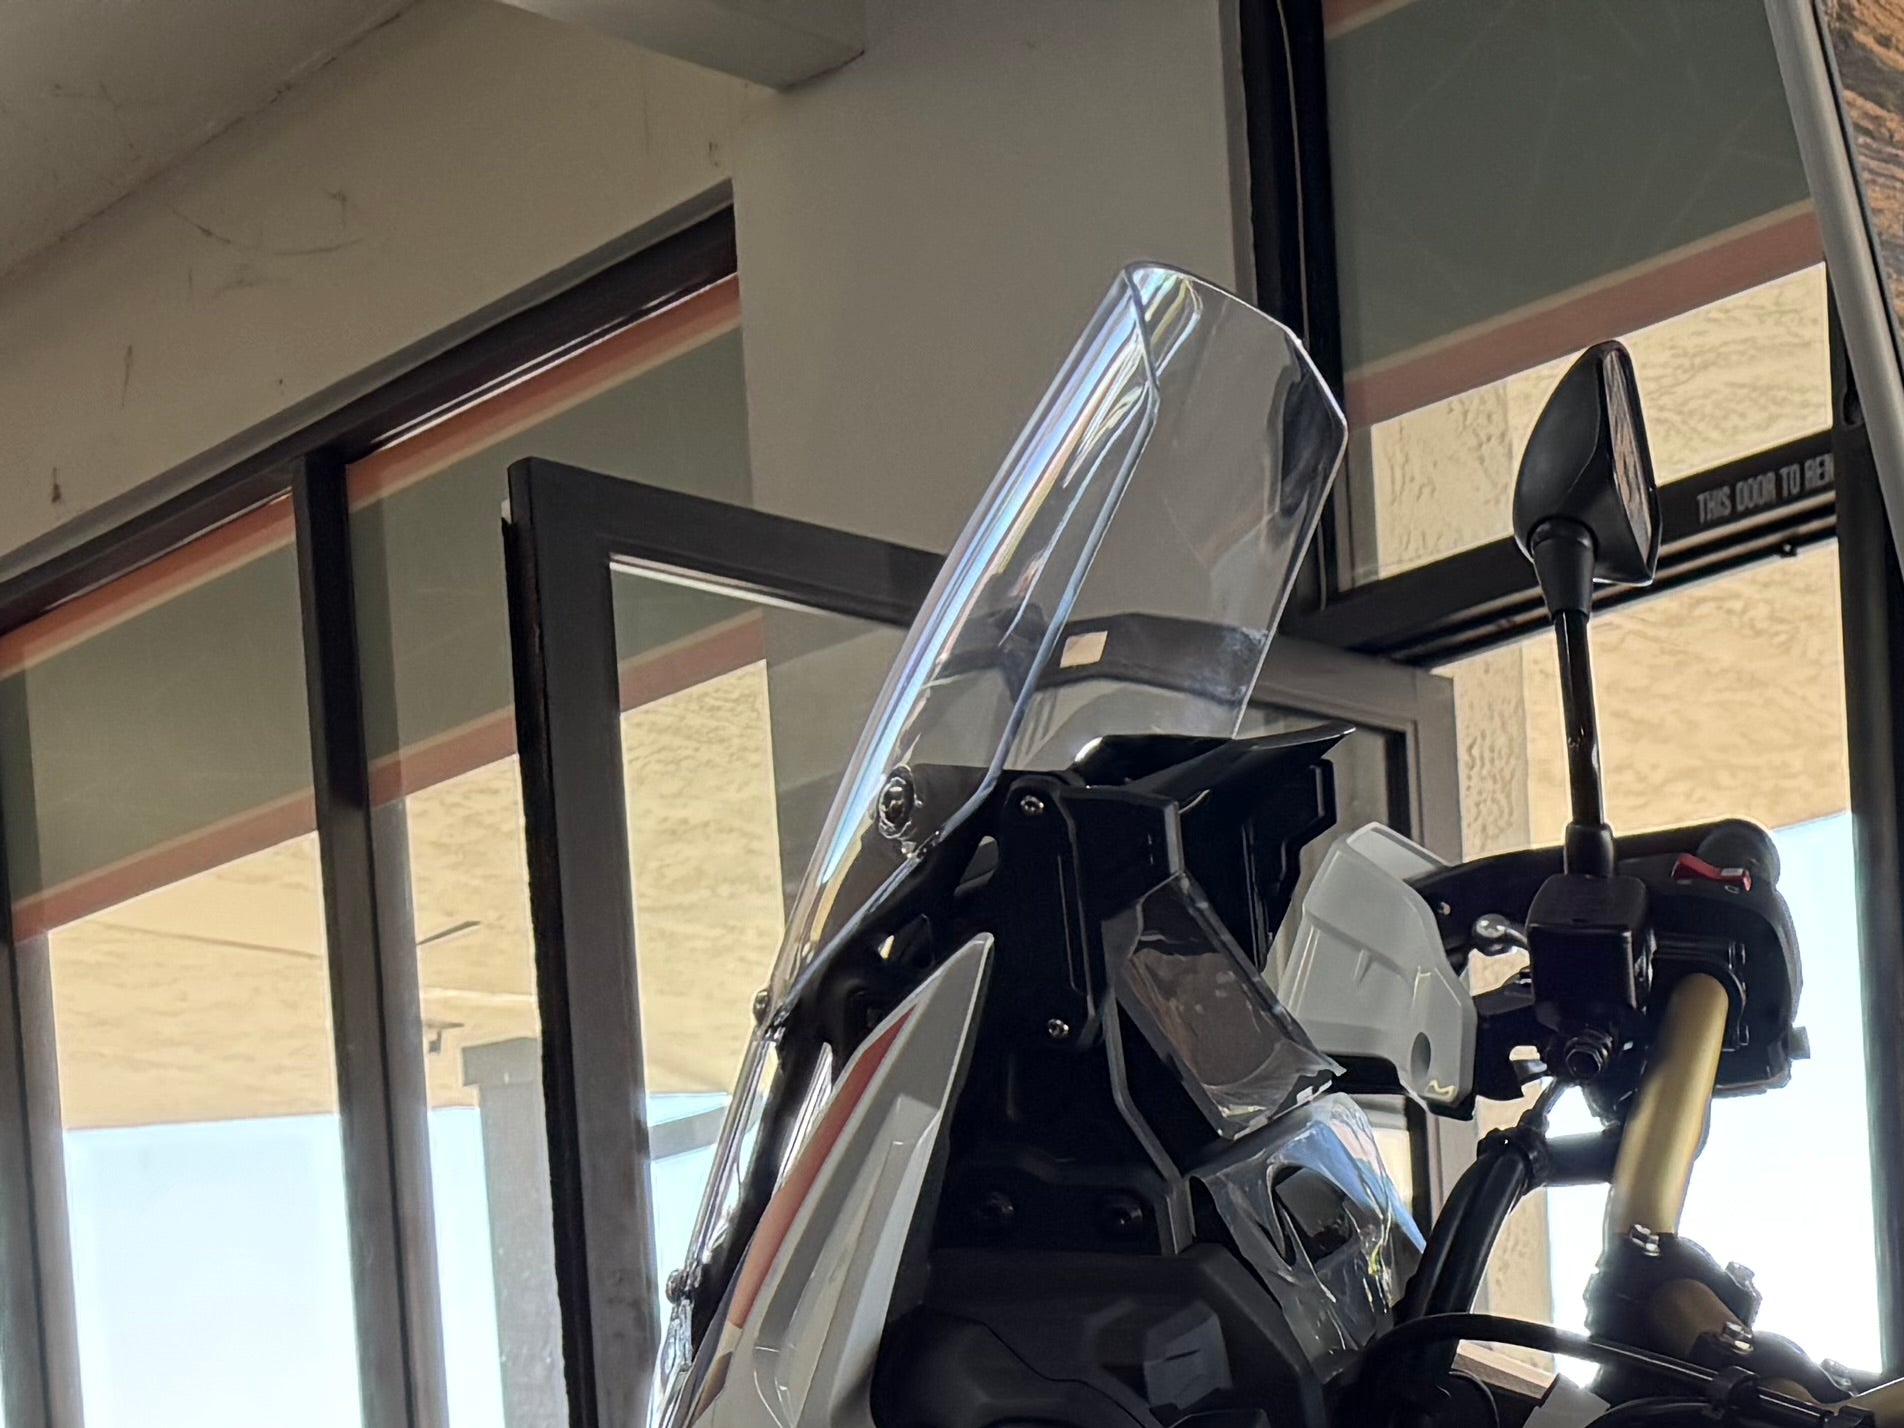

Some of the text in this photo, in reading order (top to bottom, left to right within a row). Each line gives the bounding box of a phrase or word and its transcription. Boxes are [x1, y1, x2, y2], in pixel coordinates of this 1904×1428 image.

[1697, 485, 1732, 525] THIS
[1735, 471, 1777, 513] DOOR
[1779, 463, 1801, 500] TO
